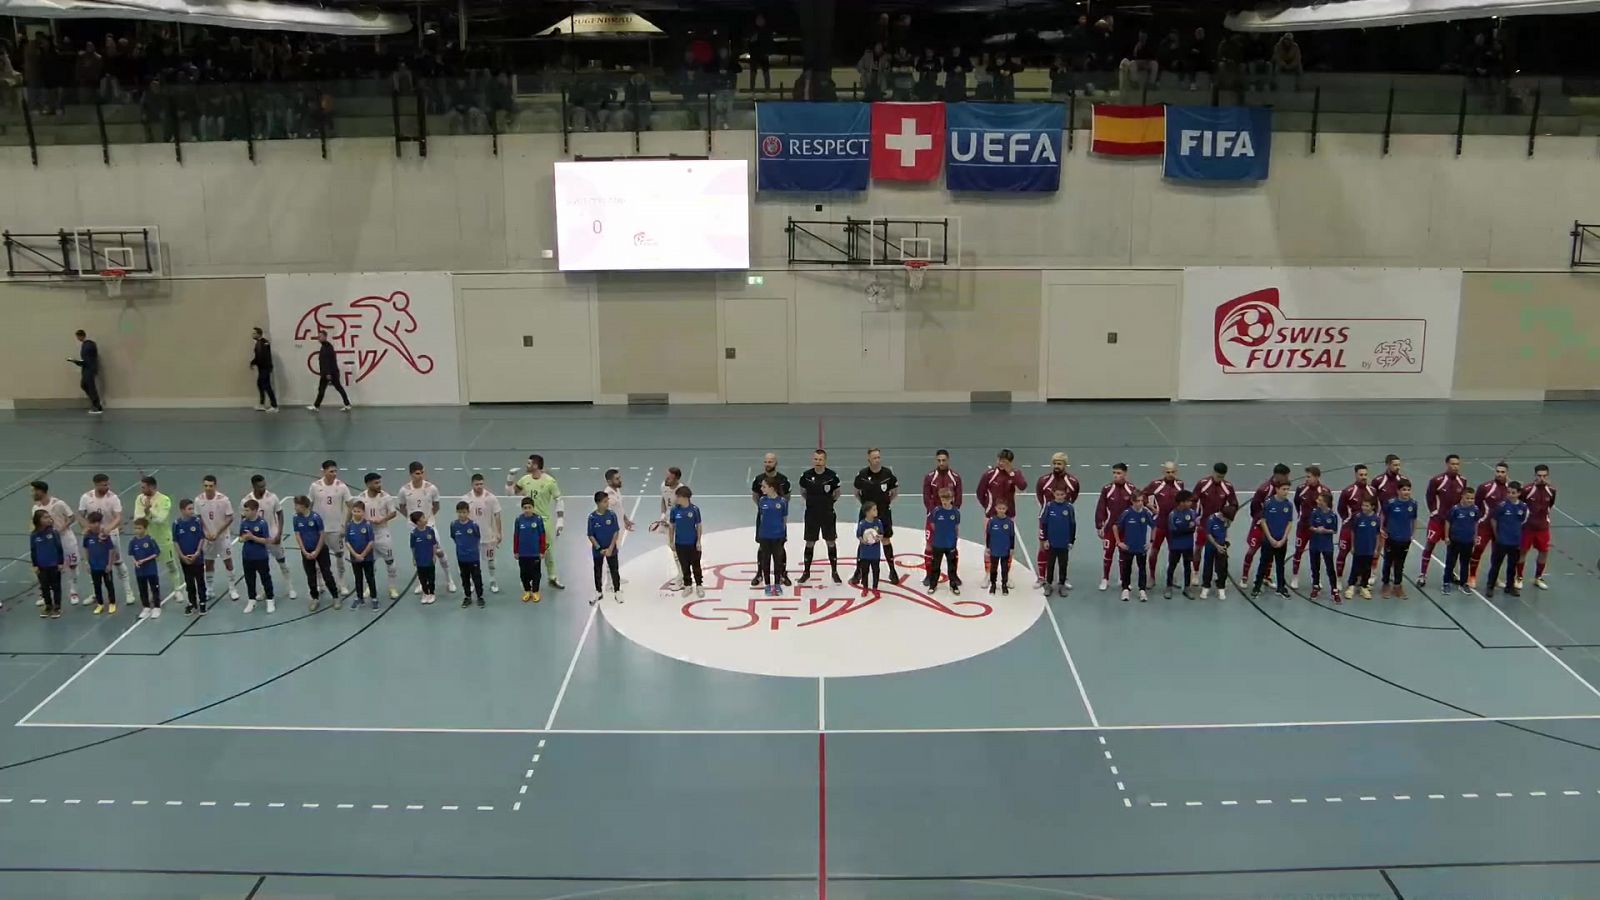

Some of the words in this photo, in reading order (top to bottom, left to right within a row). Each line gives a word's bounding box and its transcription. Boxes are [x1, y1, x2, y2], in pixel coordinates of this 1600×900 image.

[789, 139, 870, 155] RESPECT
[951, 131, 1056, 163] UEFA
[1180, 129, 1255, 157] FIFA
[593, 219, 602, 233] 0
[1274, 326, 1350, 344] SWISS
[1246, 349, 1347, 368] FUTSAL
[1361, 361, 1372, 369] by
[327, 496, 333, 505] 3
[417, 499, 422, 508] 2
